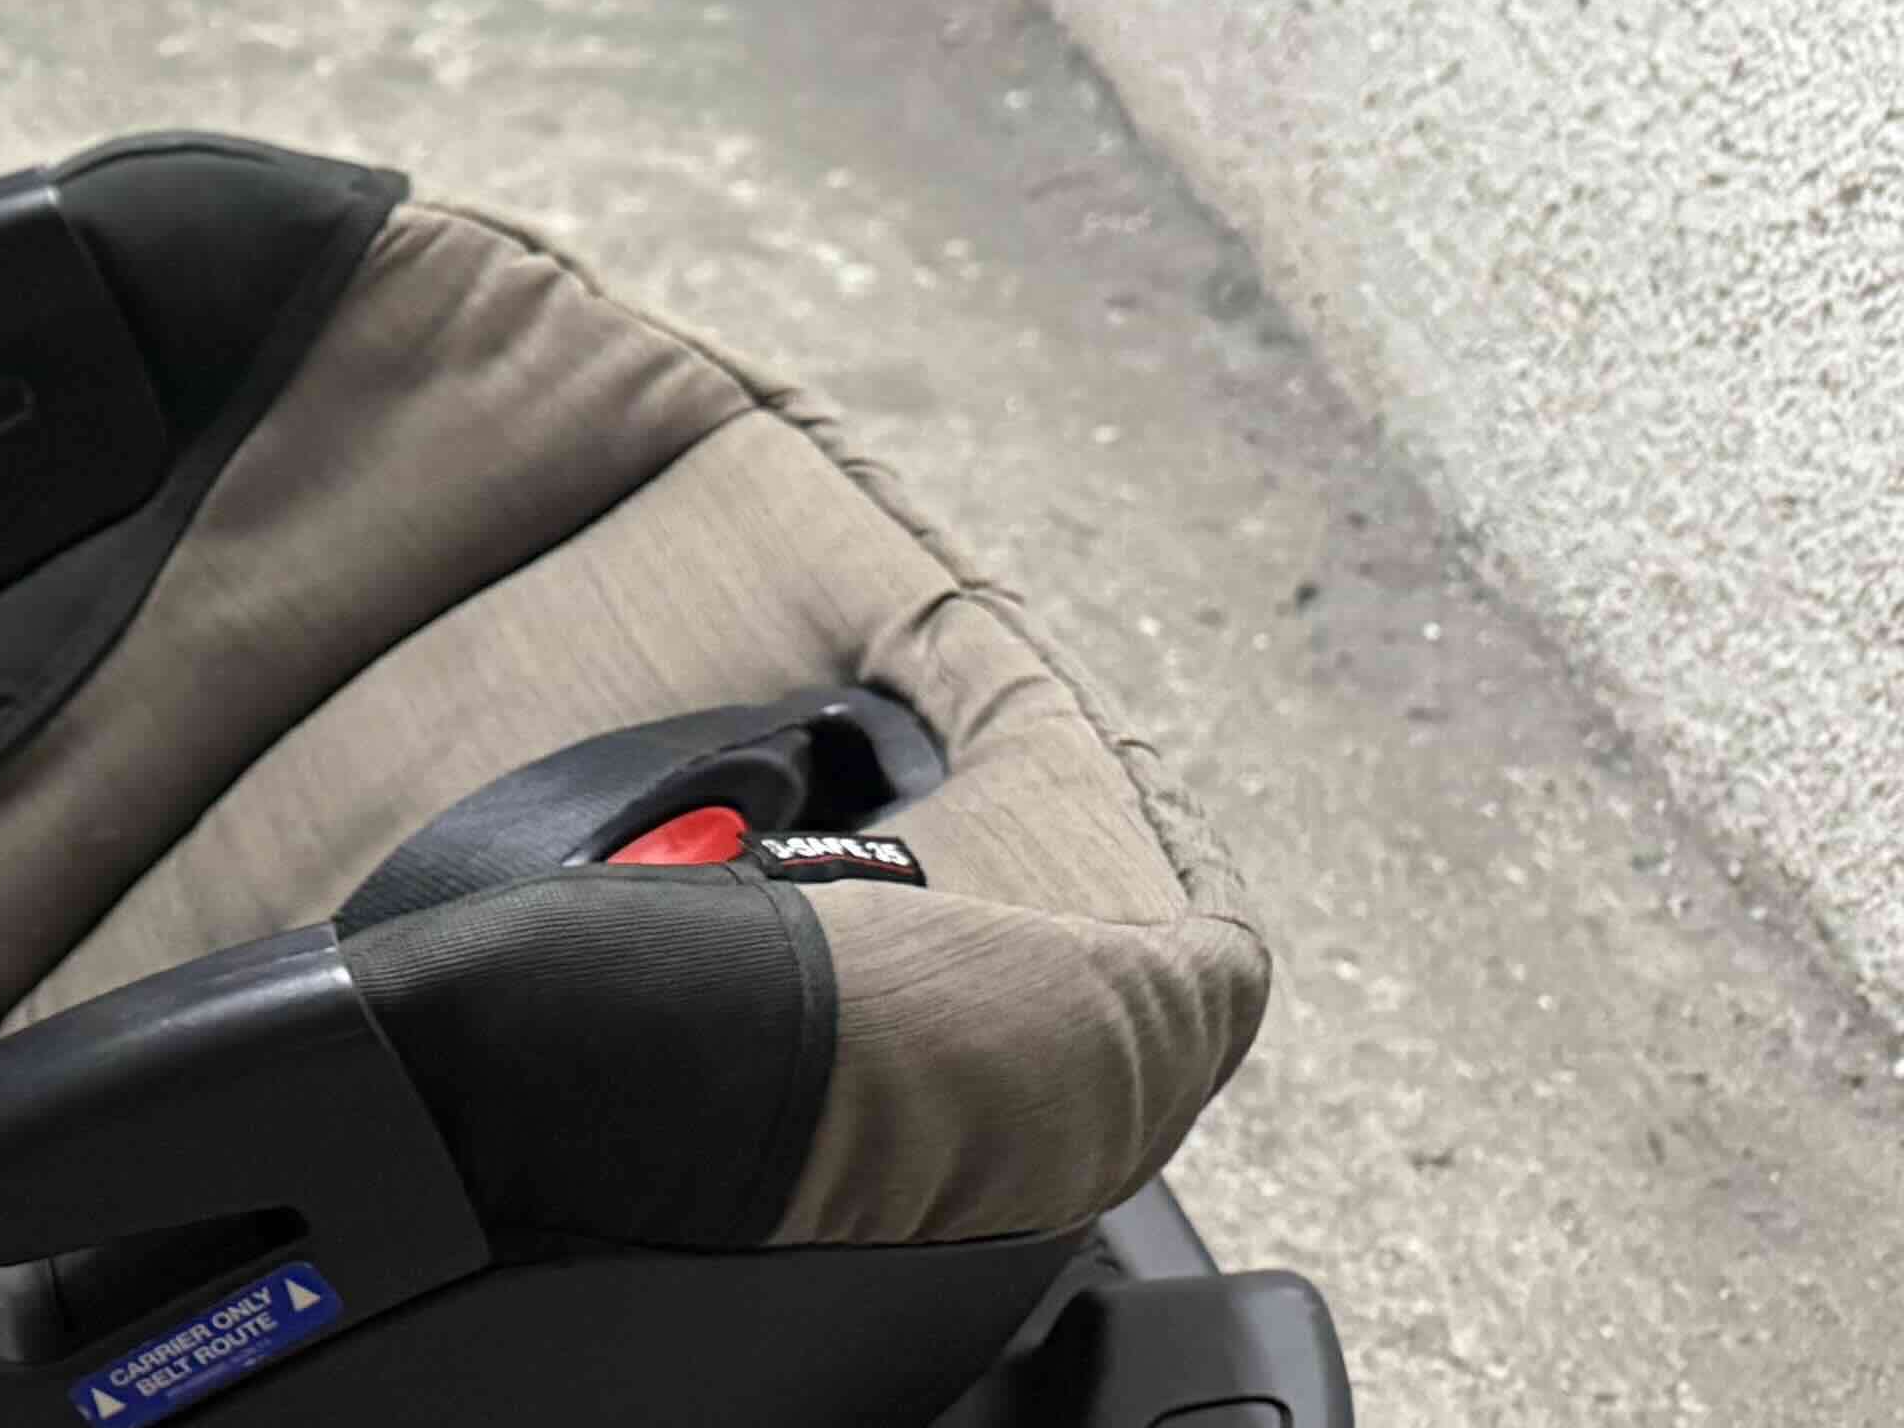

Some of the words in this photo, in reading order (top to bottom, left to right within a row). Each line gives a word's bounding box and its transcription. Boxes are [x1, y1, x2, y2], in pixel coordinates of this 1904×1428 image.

[109, 1322, 214, 1388] CARRIER
[210, 1285, 273, 1331] ONLY
[135, 1355, 194, 1398] BELT
[192, 1310, 279, 1366] ROUTE
